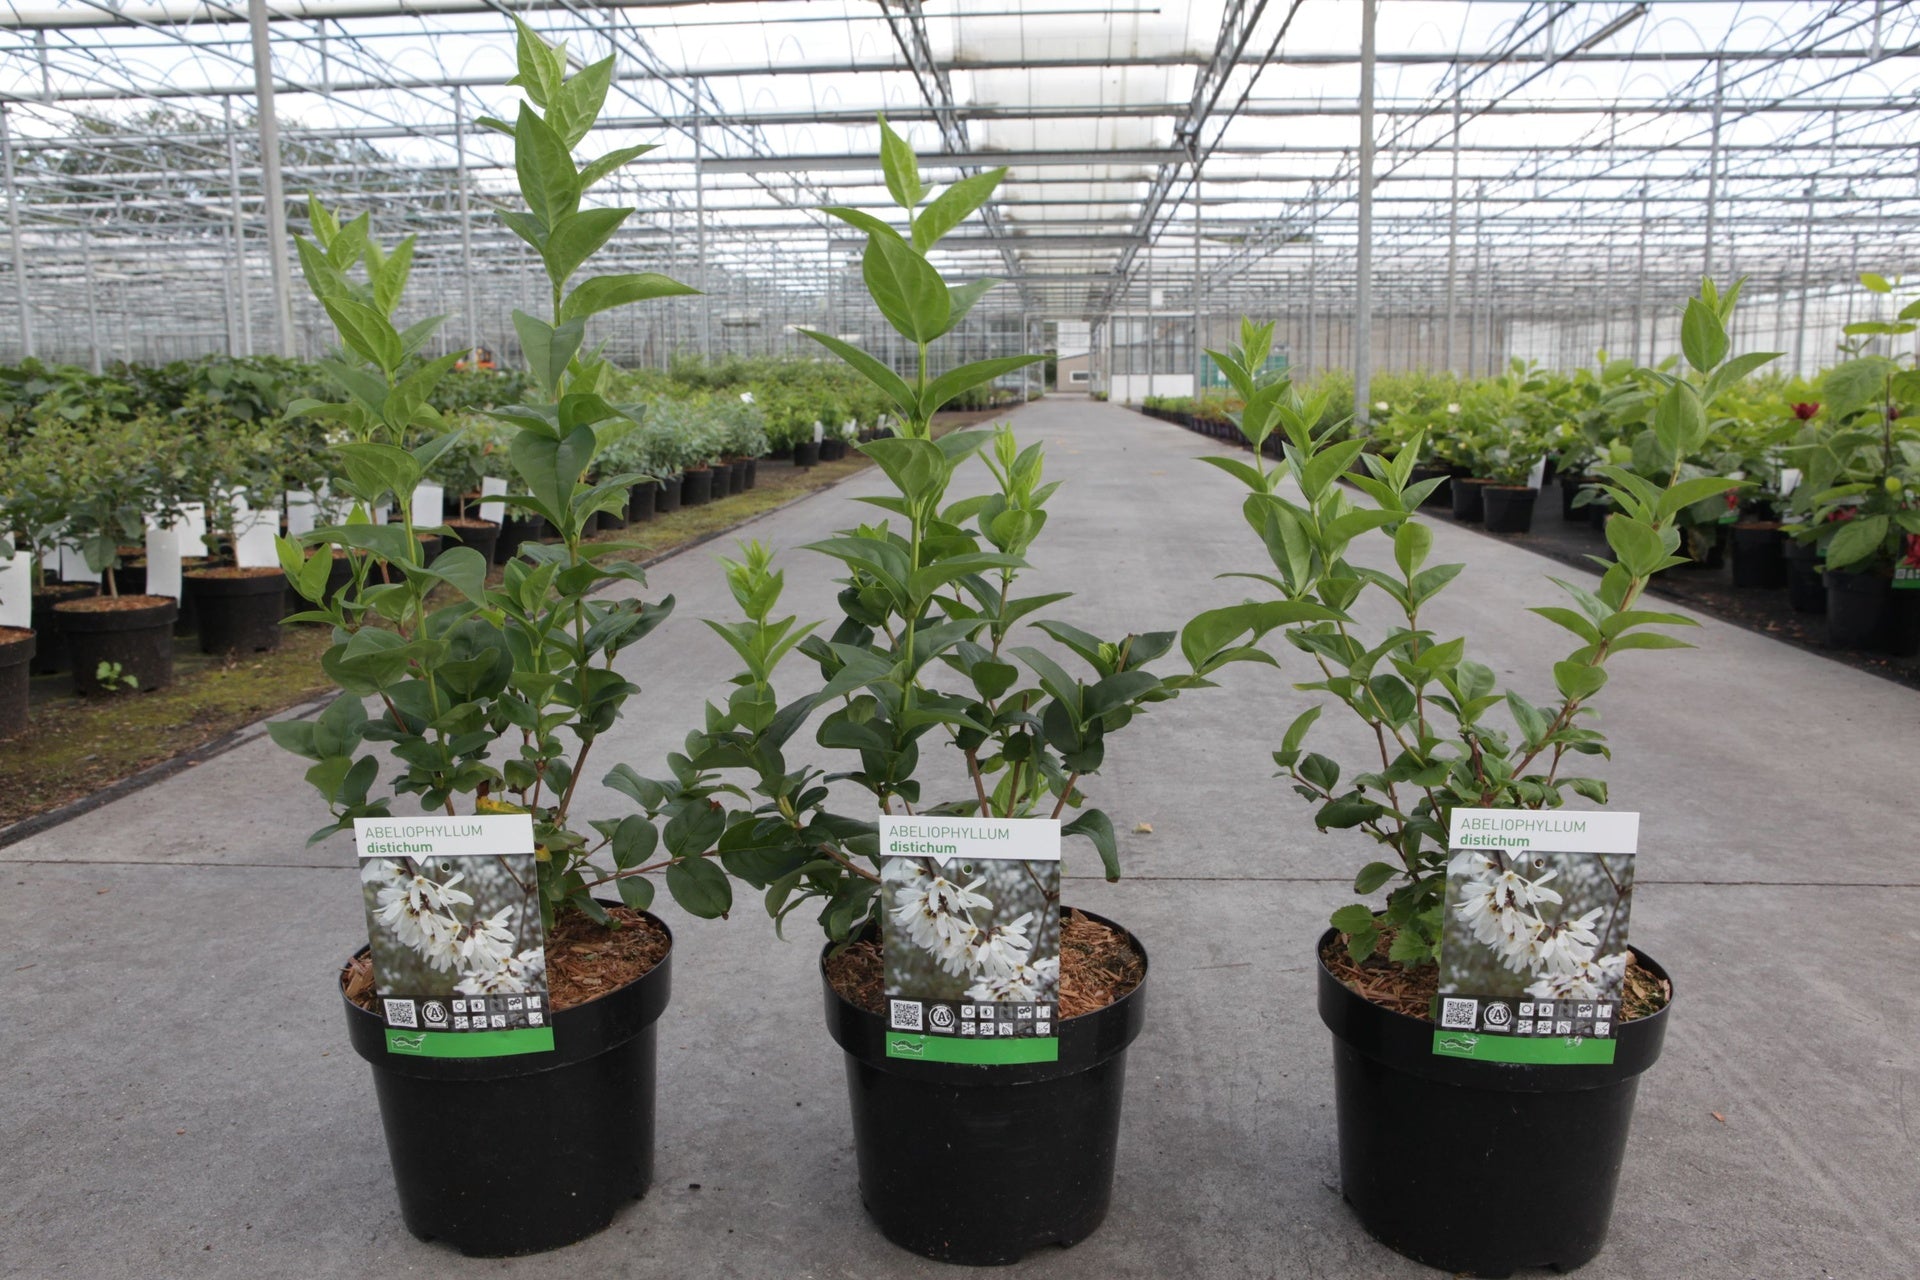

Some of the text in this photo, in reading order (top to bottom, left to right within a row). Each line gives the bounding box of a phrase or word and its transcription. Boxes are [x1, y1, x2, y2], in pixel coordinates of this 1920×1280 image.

[365, 825, 483, 839] ABELIOPHYLLUM
[1461, 818, 1586, 833] ABELIOPHYLLUM
[889, 825, 1009, 840] ABELIOPHYLLUM
[1460, 834, 1530, 847] distichum
[367, 842, 433, 854] distichum
[890, 841, 957, 854] distichum
